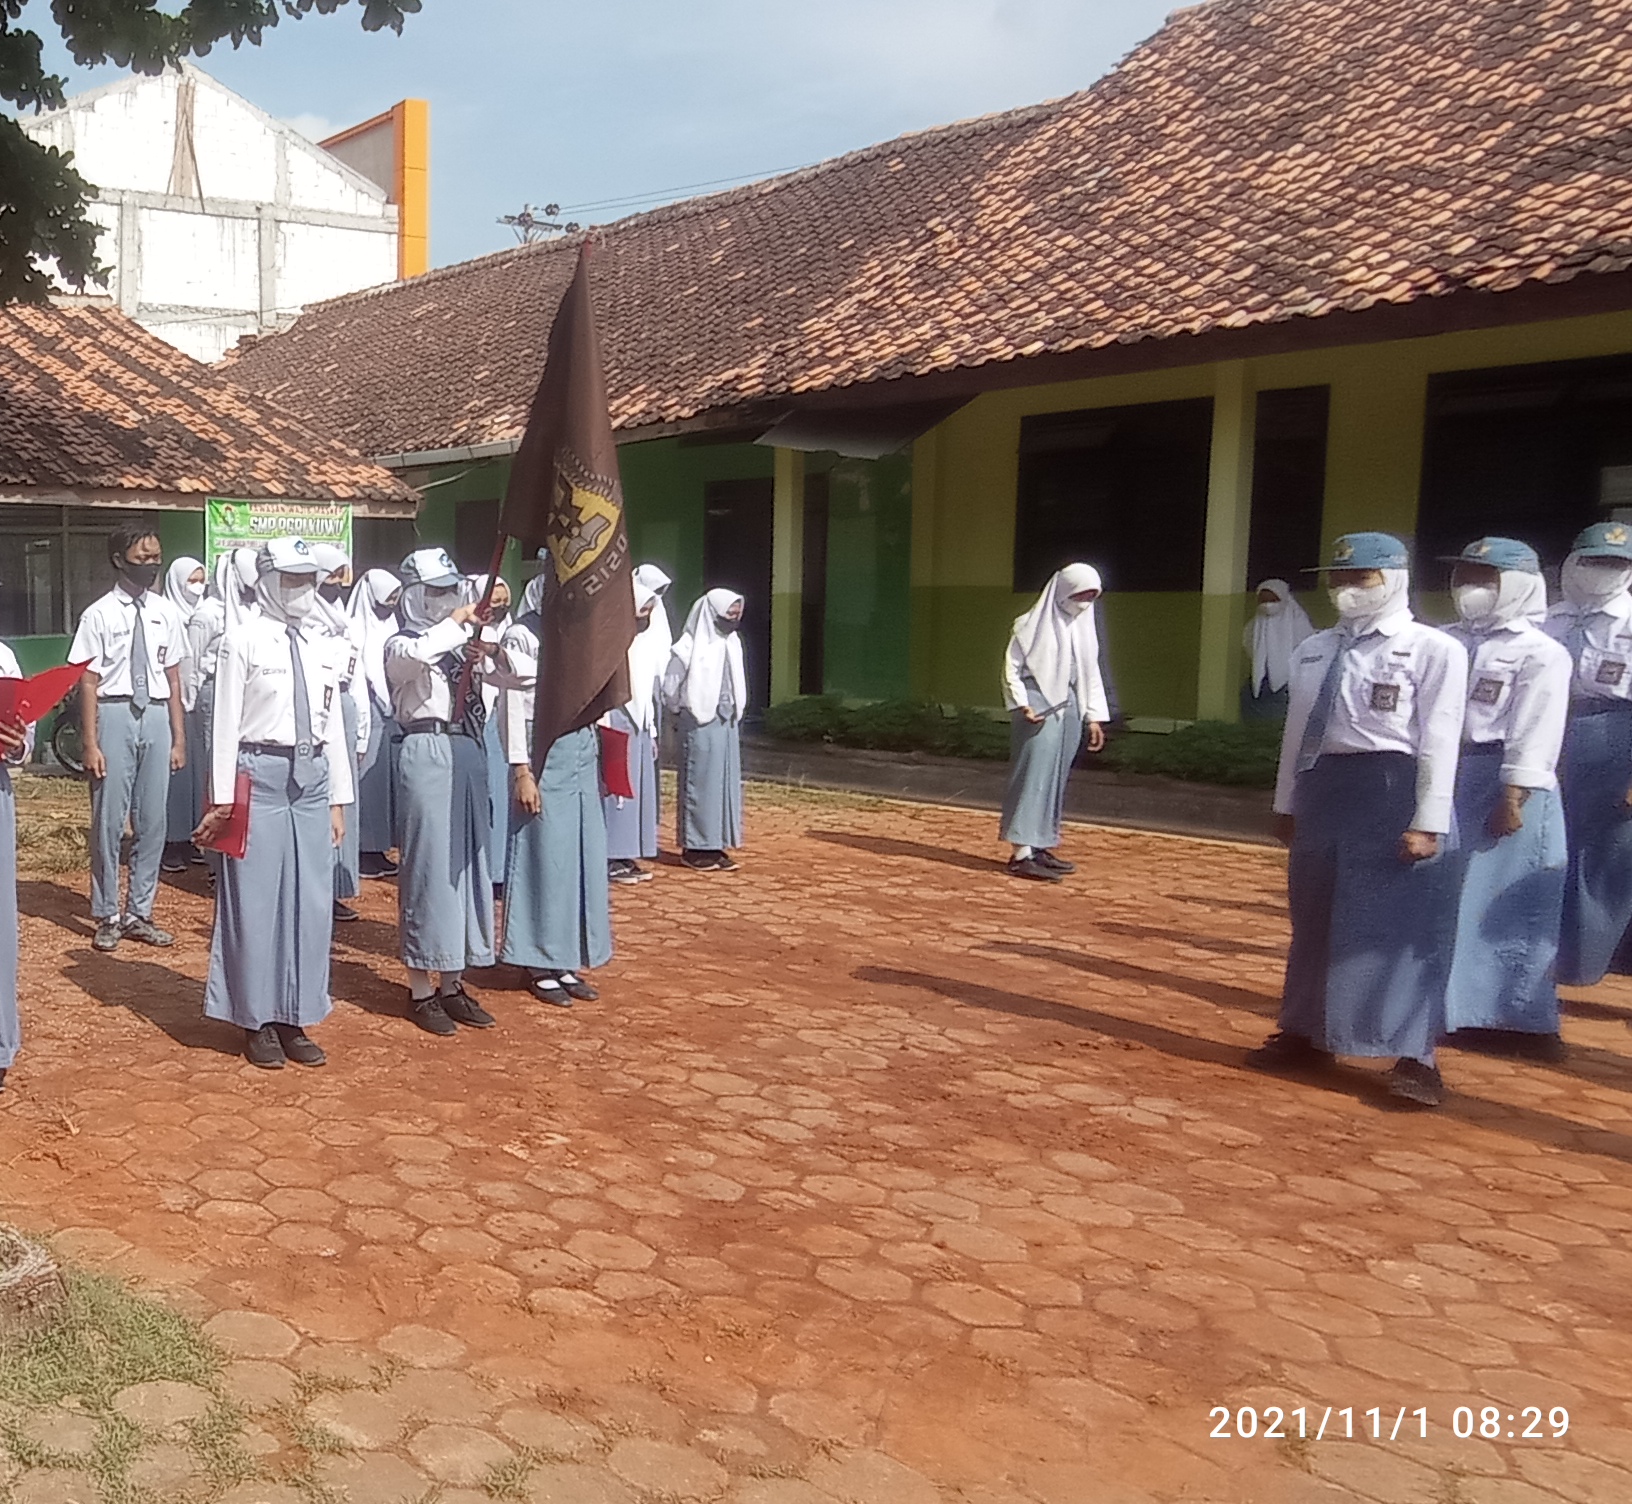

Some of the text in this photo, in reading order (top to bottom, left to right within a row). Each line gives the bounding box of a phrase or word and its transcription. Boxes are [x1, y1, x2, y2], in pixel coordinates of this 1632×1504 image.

[249, 516, 276, 534] SMP
[278, 517, 306, 535] PGRI
[308, 518, 344, 536] KUWU
